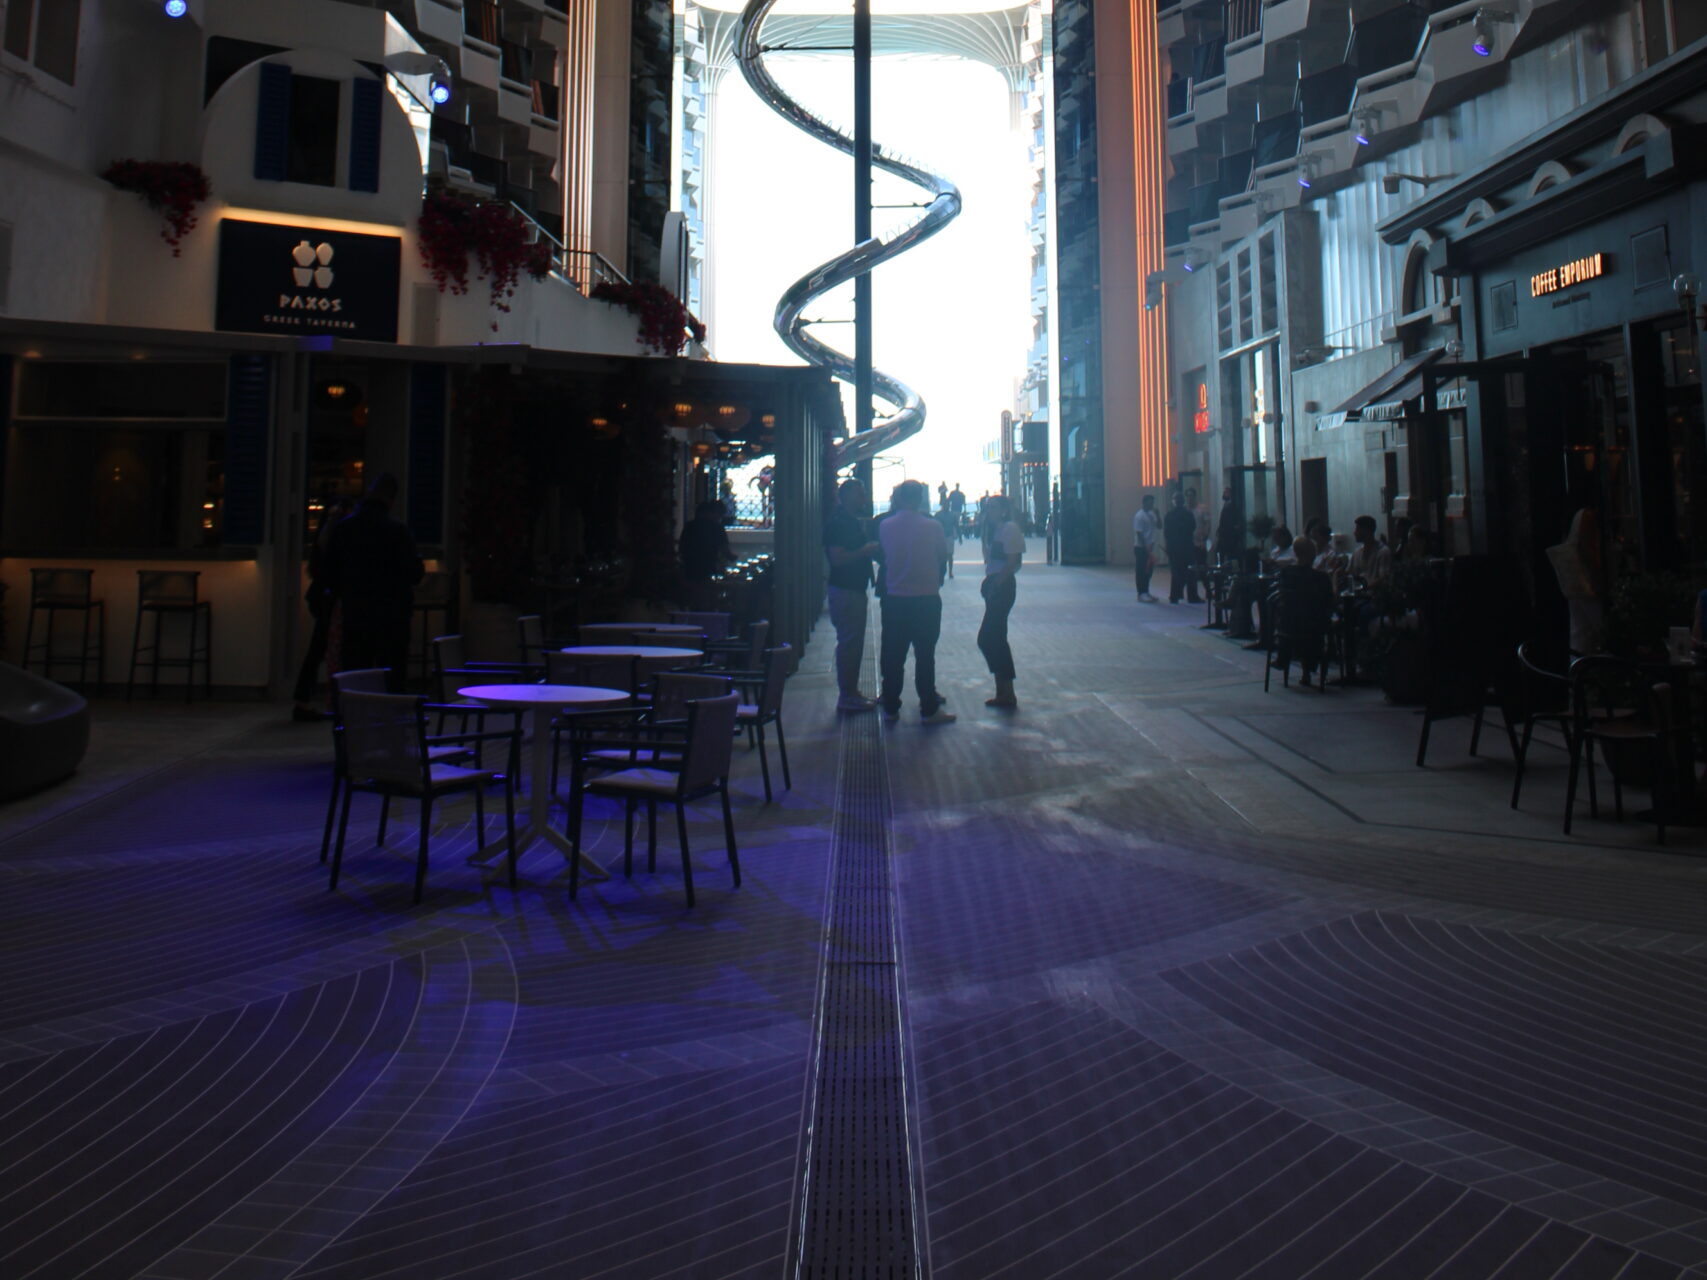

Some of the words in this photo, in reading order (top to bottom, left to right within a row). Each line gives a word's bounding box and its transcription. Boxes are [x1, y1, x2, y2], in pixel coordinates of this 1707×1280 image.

[1531, 268, 1558, 298] COFFEE
[1560, 252, 1603, 288] EMPORIUM
[279, 293, 342, 312] PAXOS
